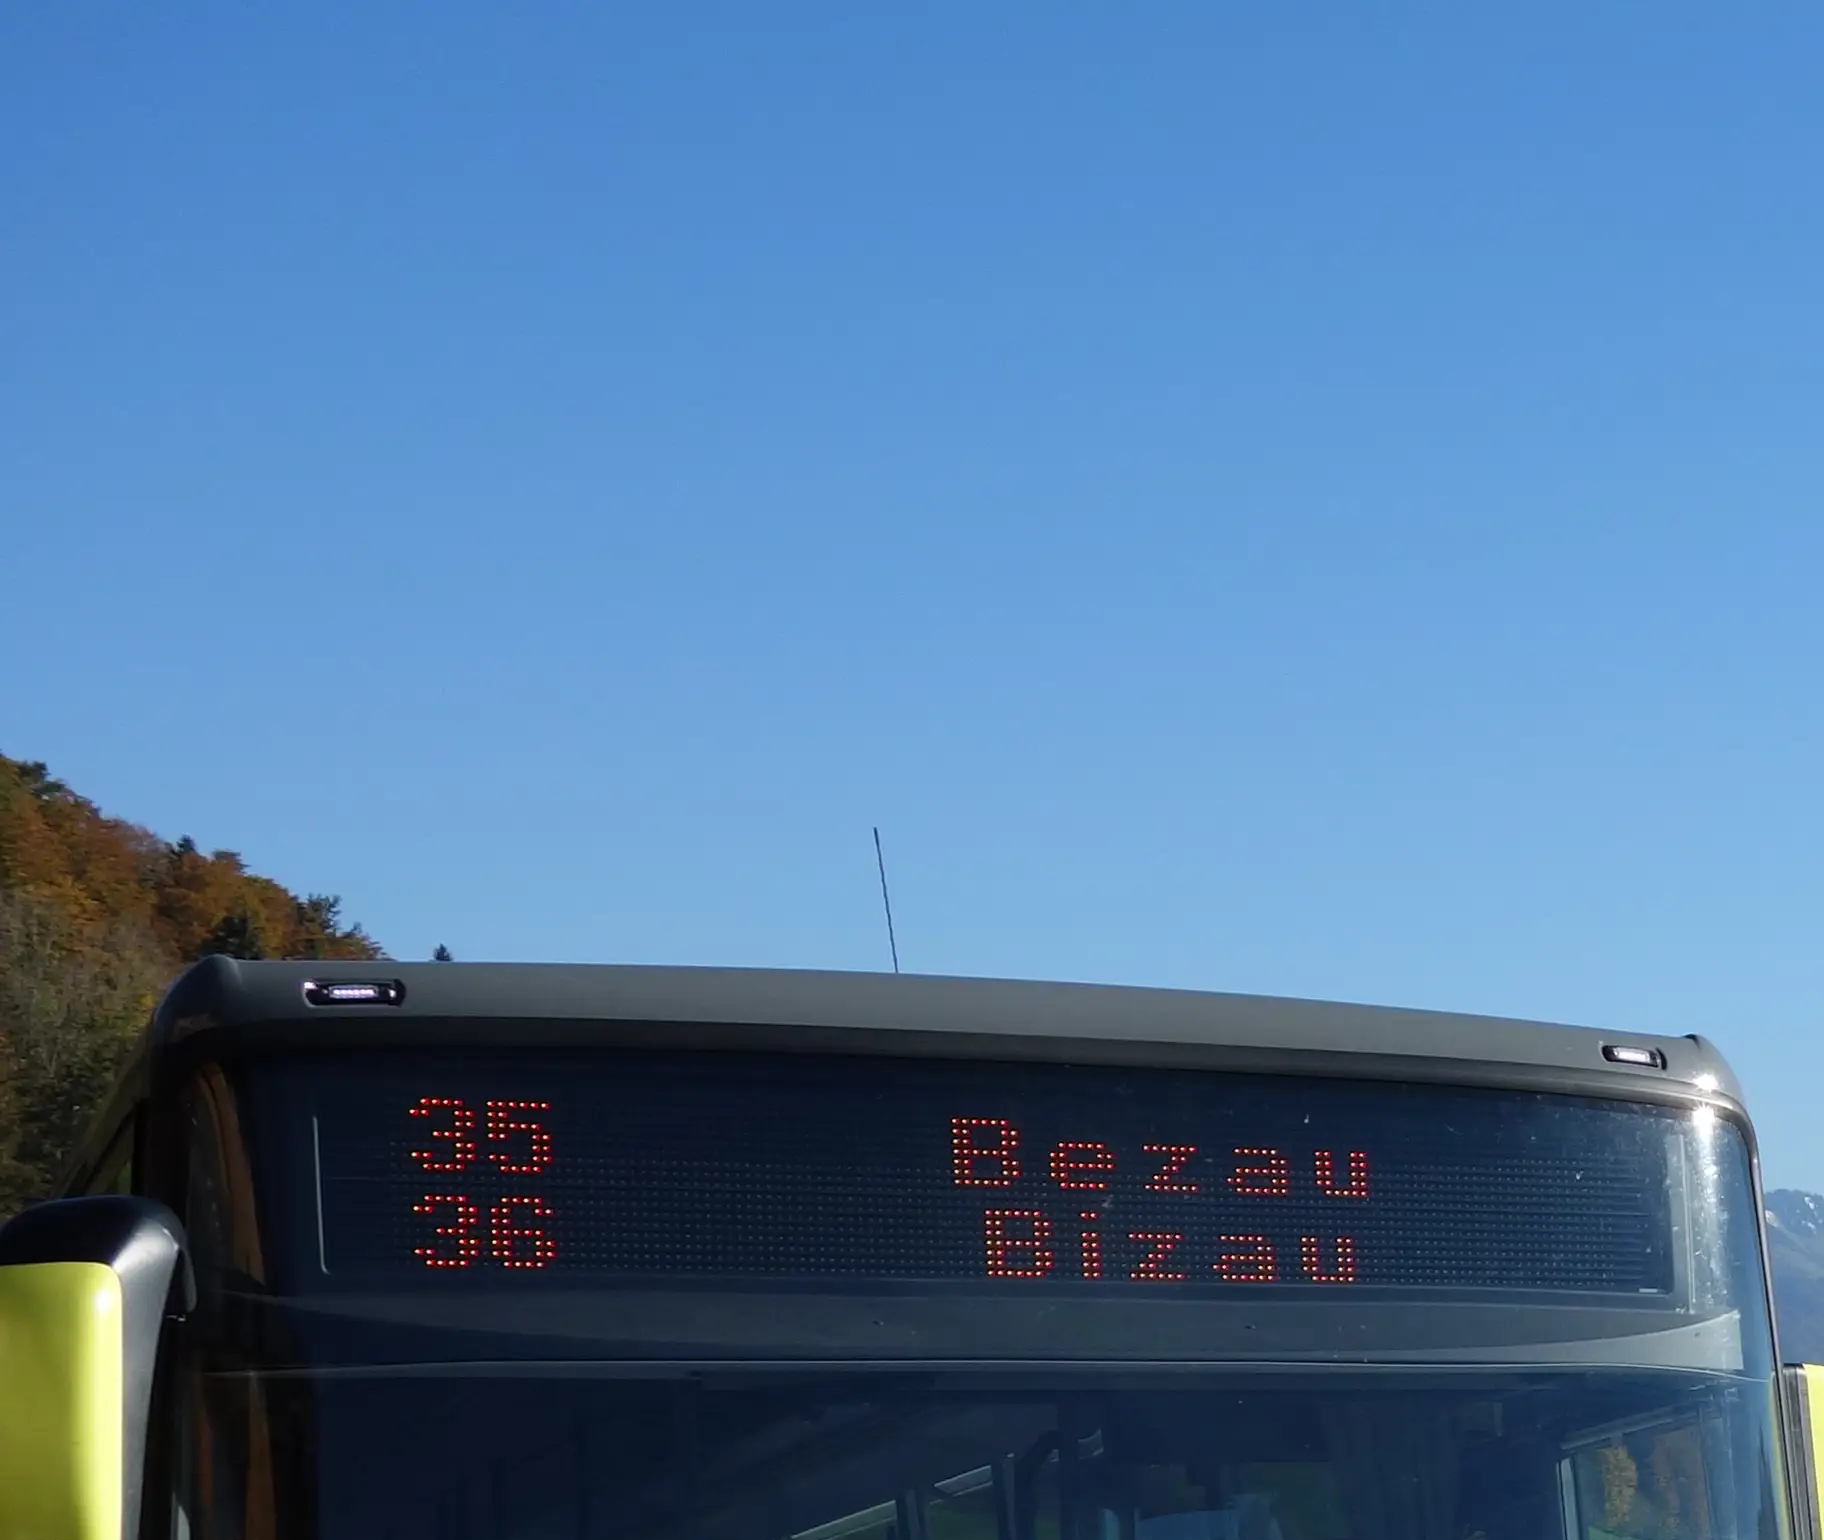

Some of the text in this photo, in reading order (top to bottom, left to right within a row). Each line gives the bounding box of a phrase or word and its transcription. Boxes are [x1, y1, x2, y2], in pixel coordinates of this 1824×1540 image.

[409, 1096, 552, 1174] 35
[950, 1115, 1369, 1200] Bezau
[412, 1194, 557, 1269] 36
[984, 1208, 1356, 1283] Bizau
